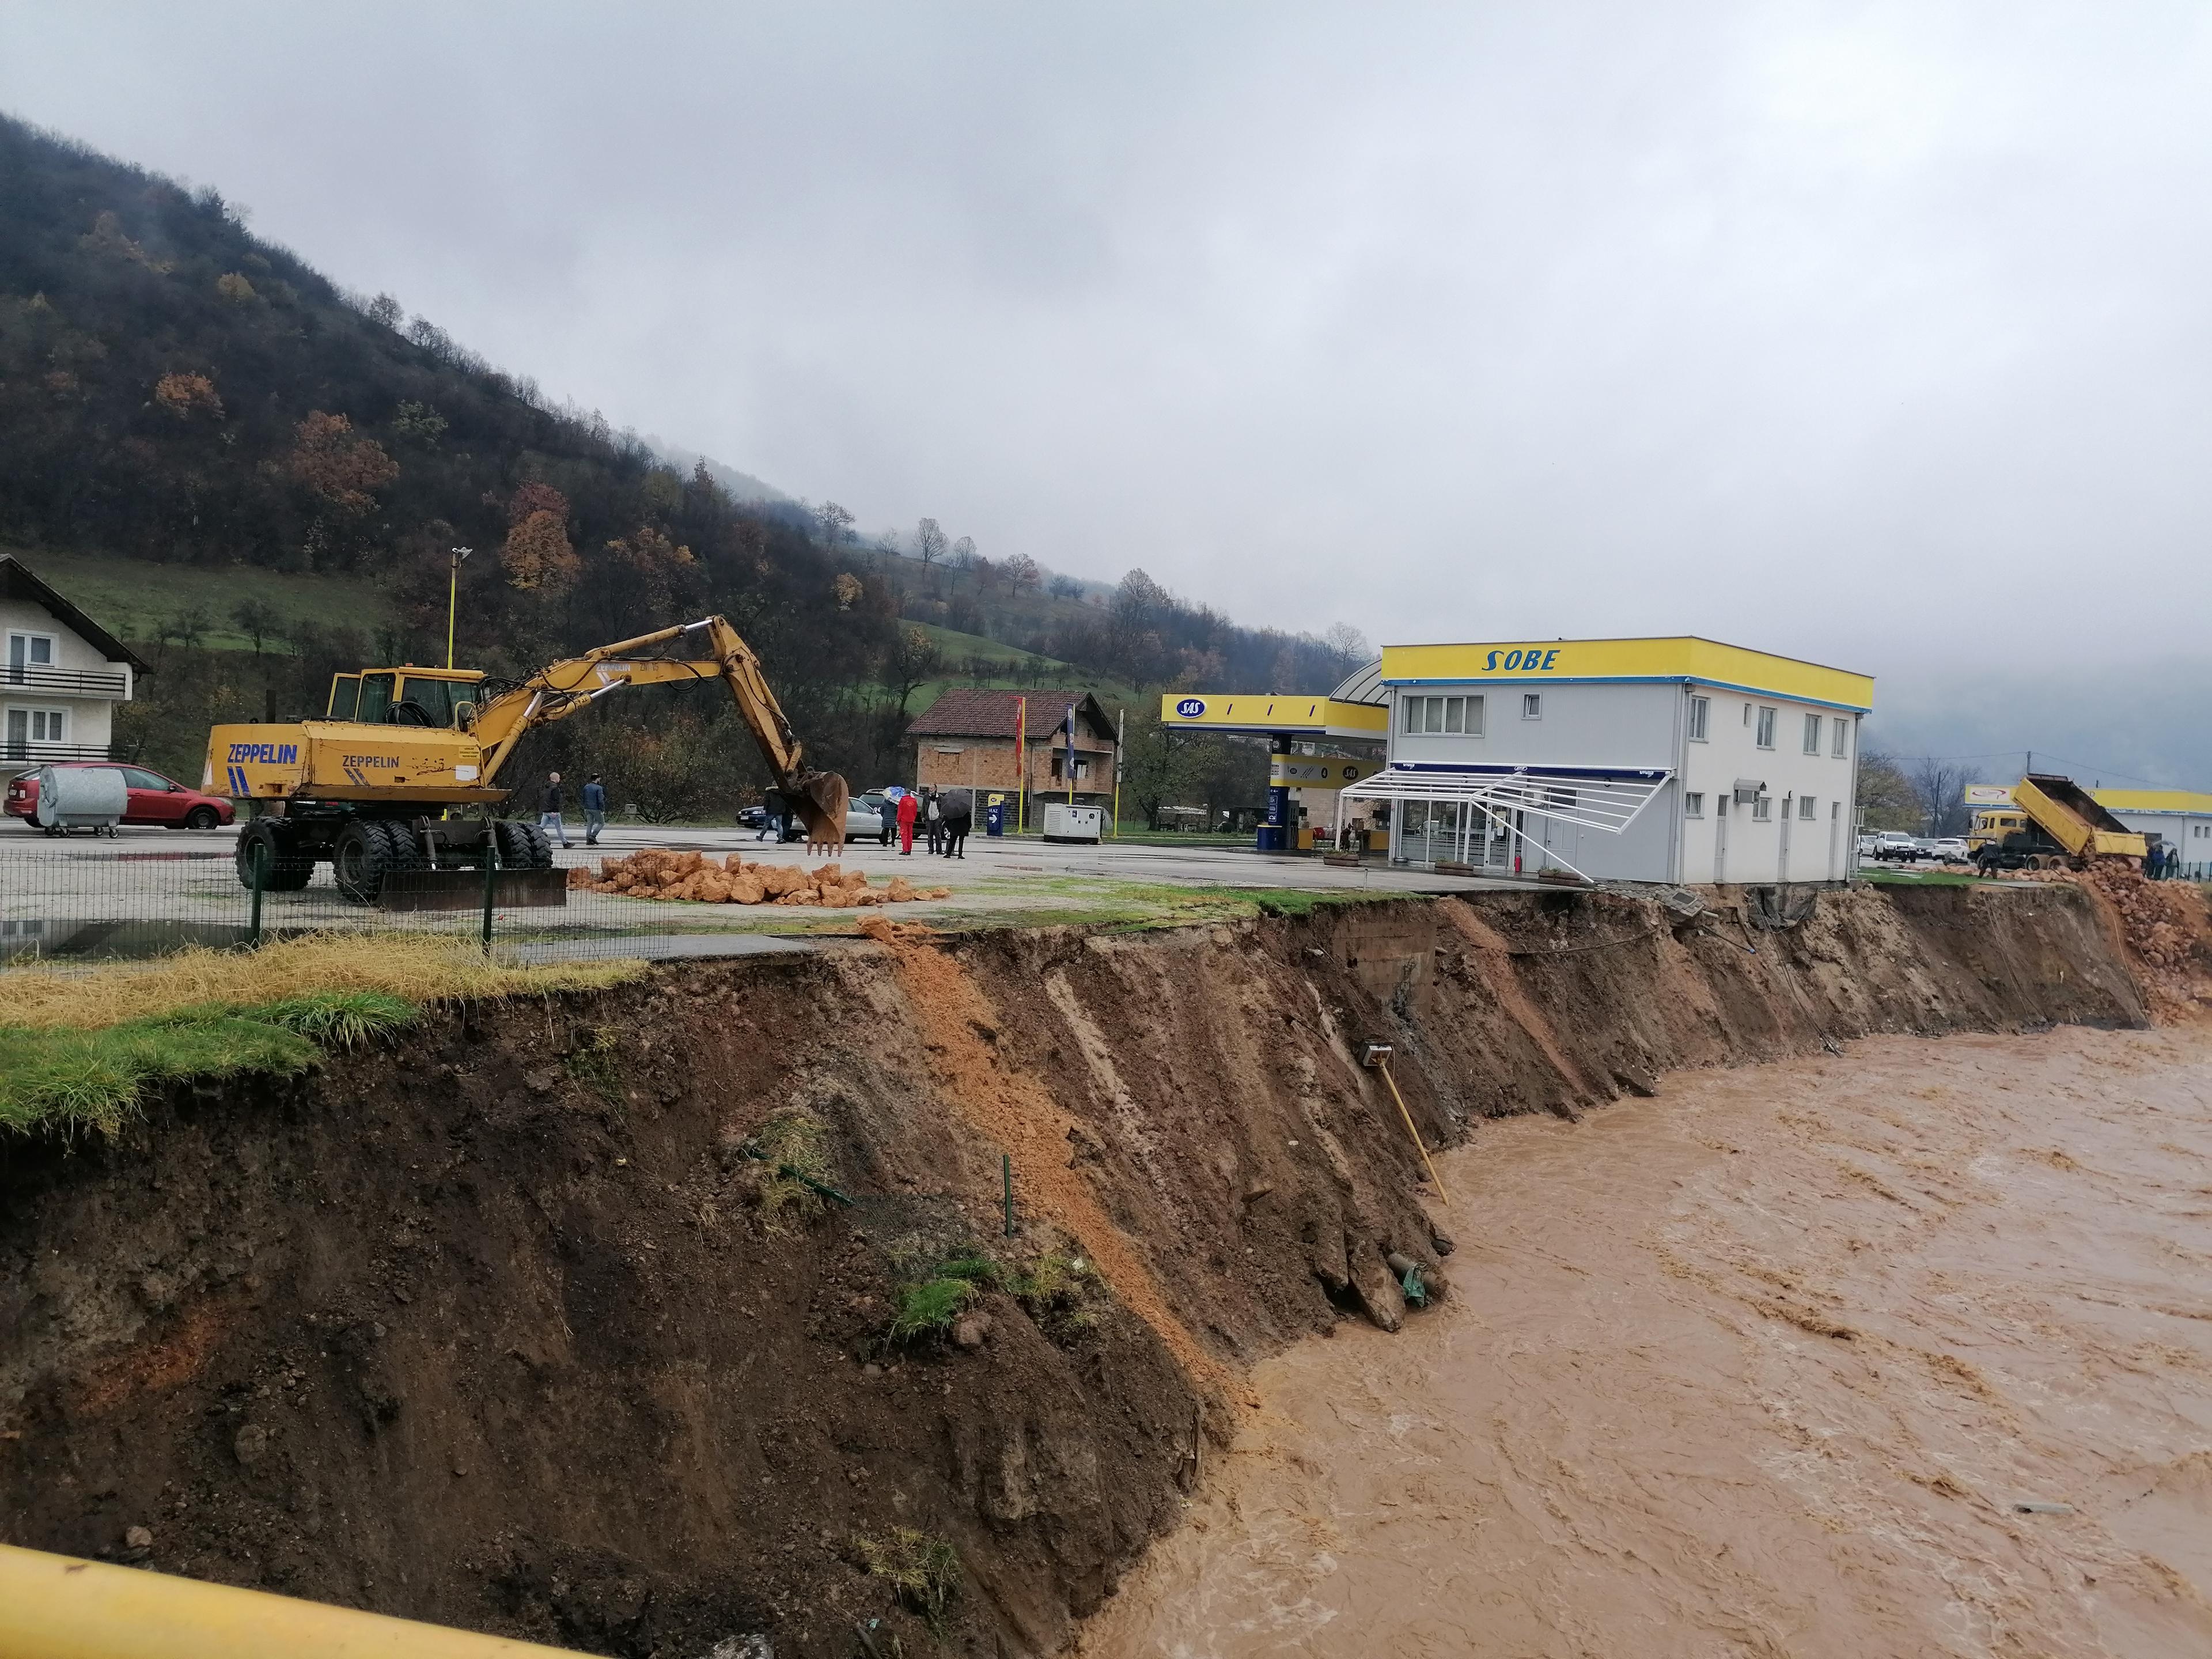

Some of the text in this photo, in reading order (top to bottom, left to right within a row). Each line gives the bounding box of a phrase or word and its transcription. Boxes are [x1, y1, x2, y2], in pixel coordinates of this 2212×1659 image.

[1481, 650, 1561, 671] SOBE
[1181, 702, 1200, 714] SAS
[227, 744, 298, 764] ZEPPELIN
[342, 755, 400, 768] ZEPPELIN
[1344, 769, 1357, 778] SAS
